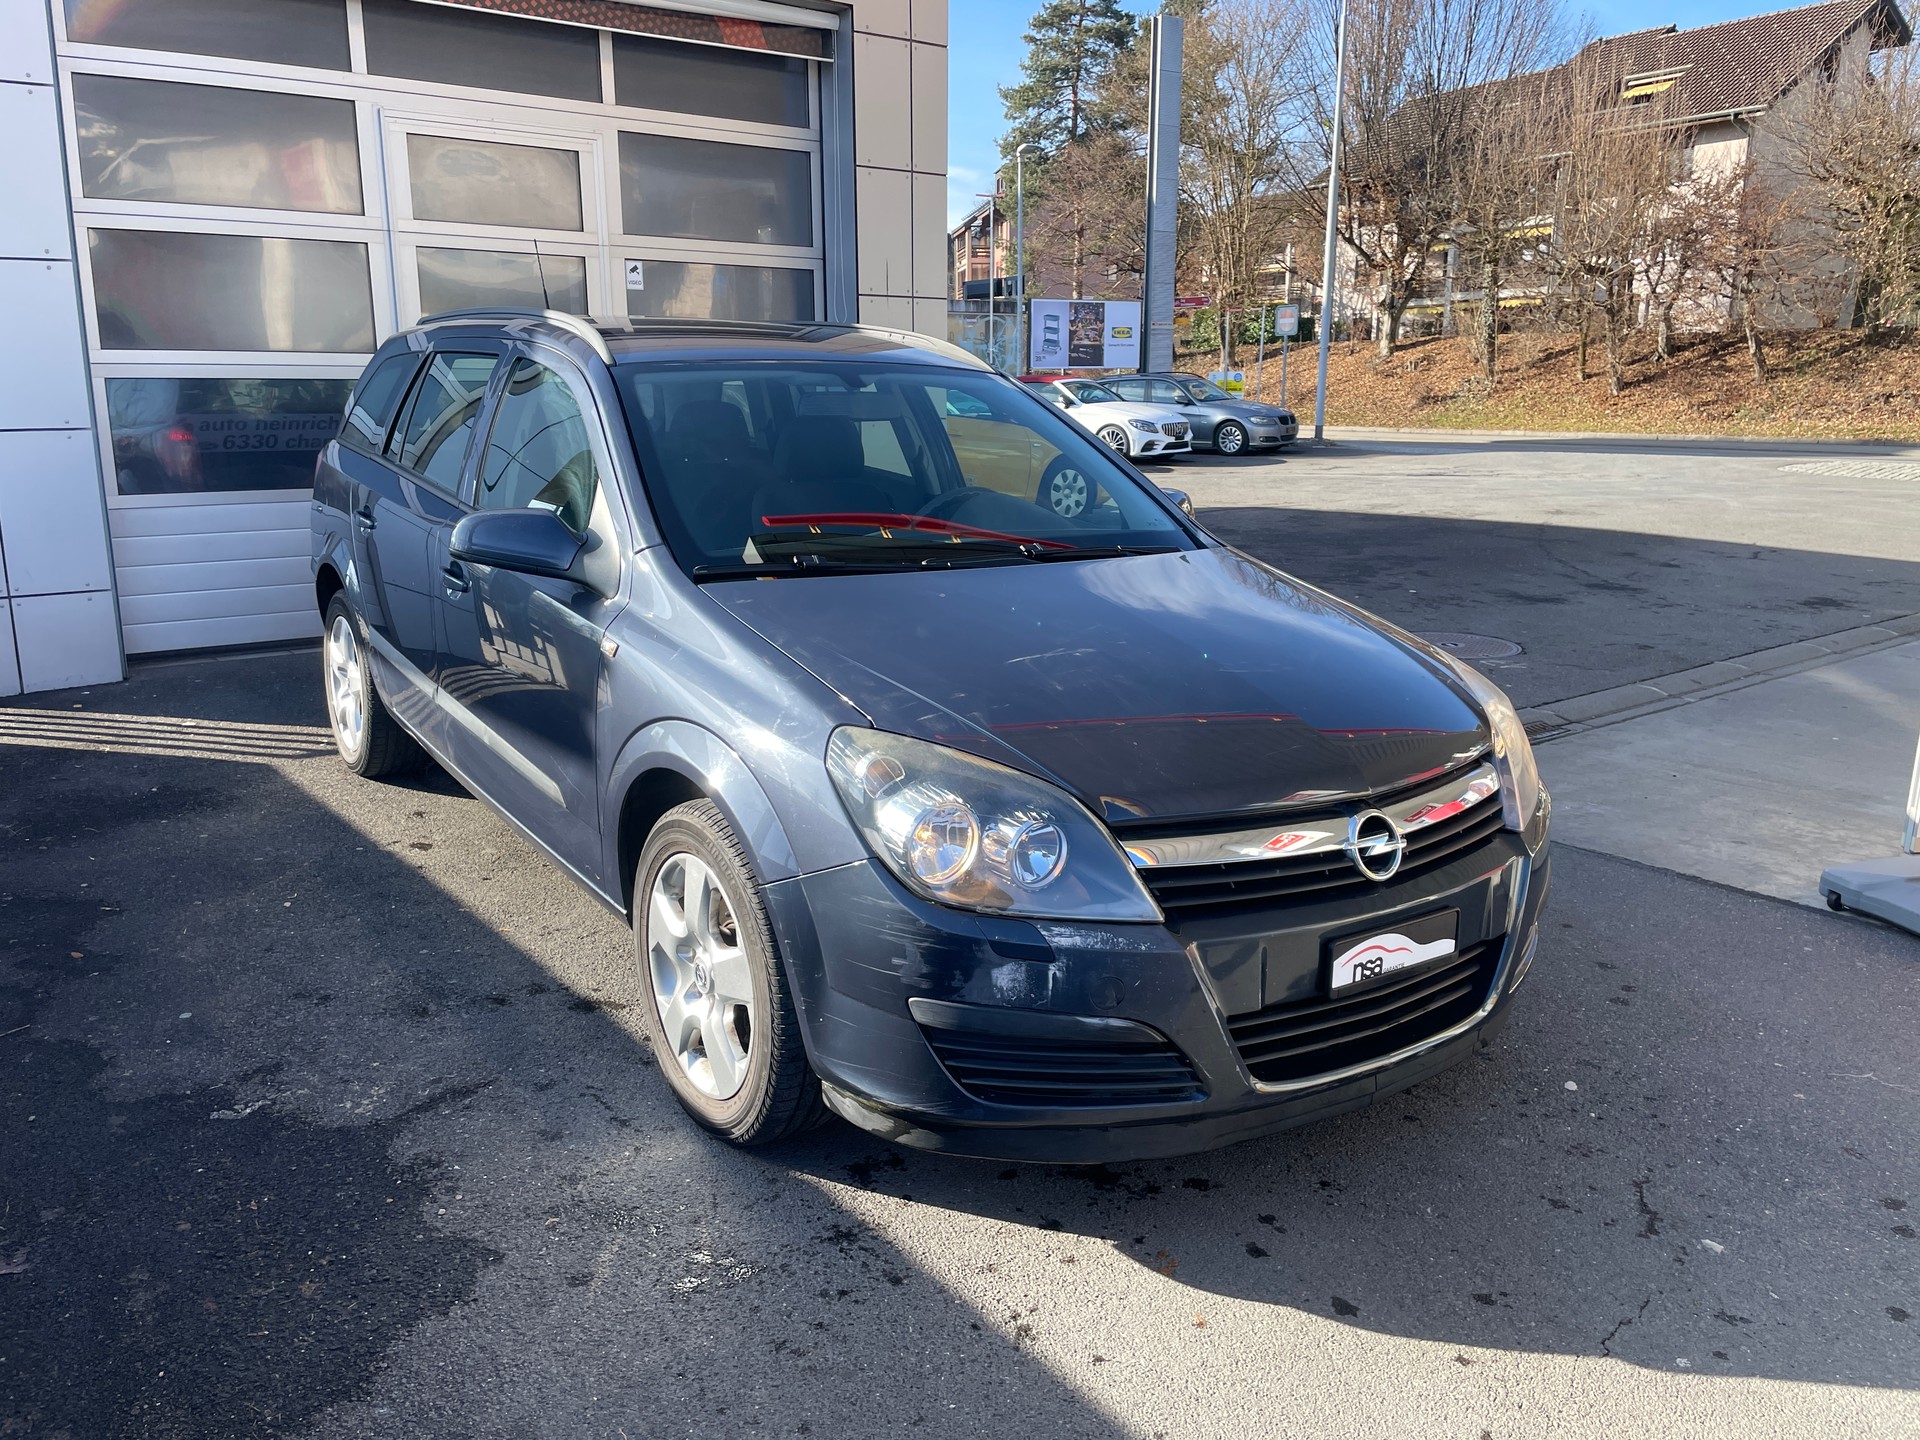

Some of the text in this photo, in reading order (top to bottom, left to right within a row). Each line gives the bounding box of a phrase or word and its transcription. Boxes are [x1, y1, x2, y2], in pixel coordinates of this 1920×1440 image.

[199, 418, 247, 432] auto
[222, 433, 279, 450] 6330
[1352, 956, 1384, 983] nsa
